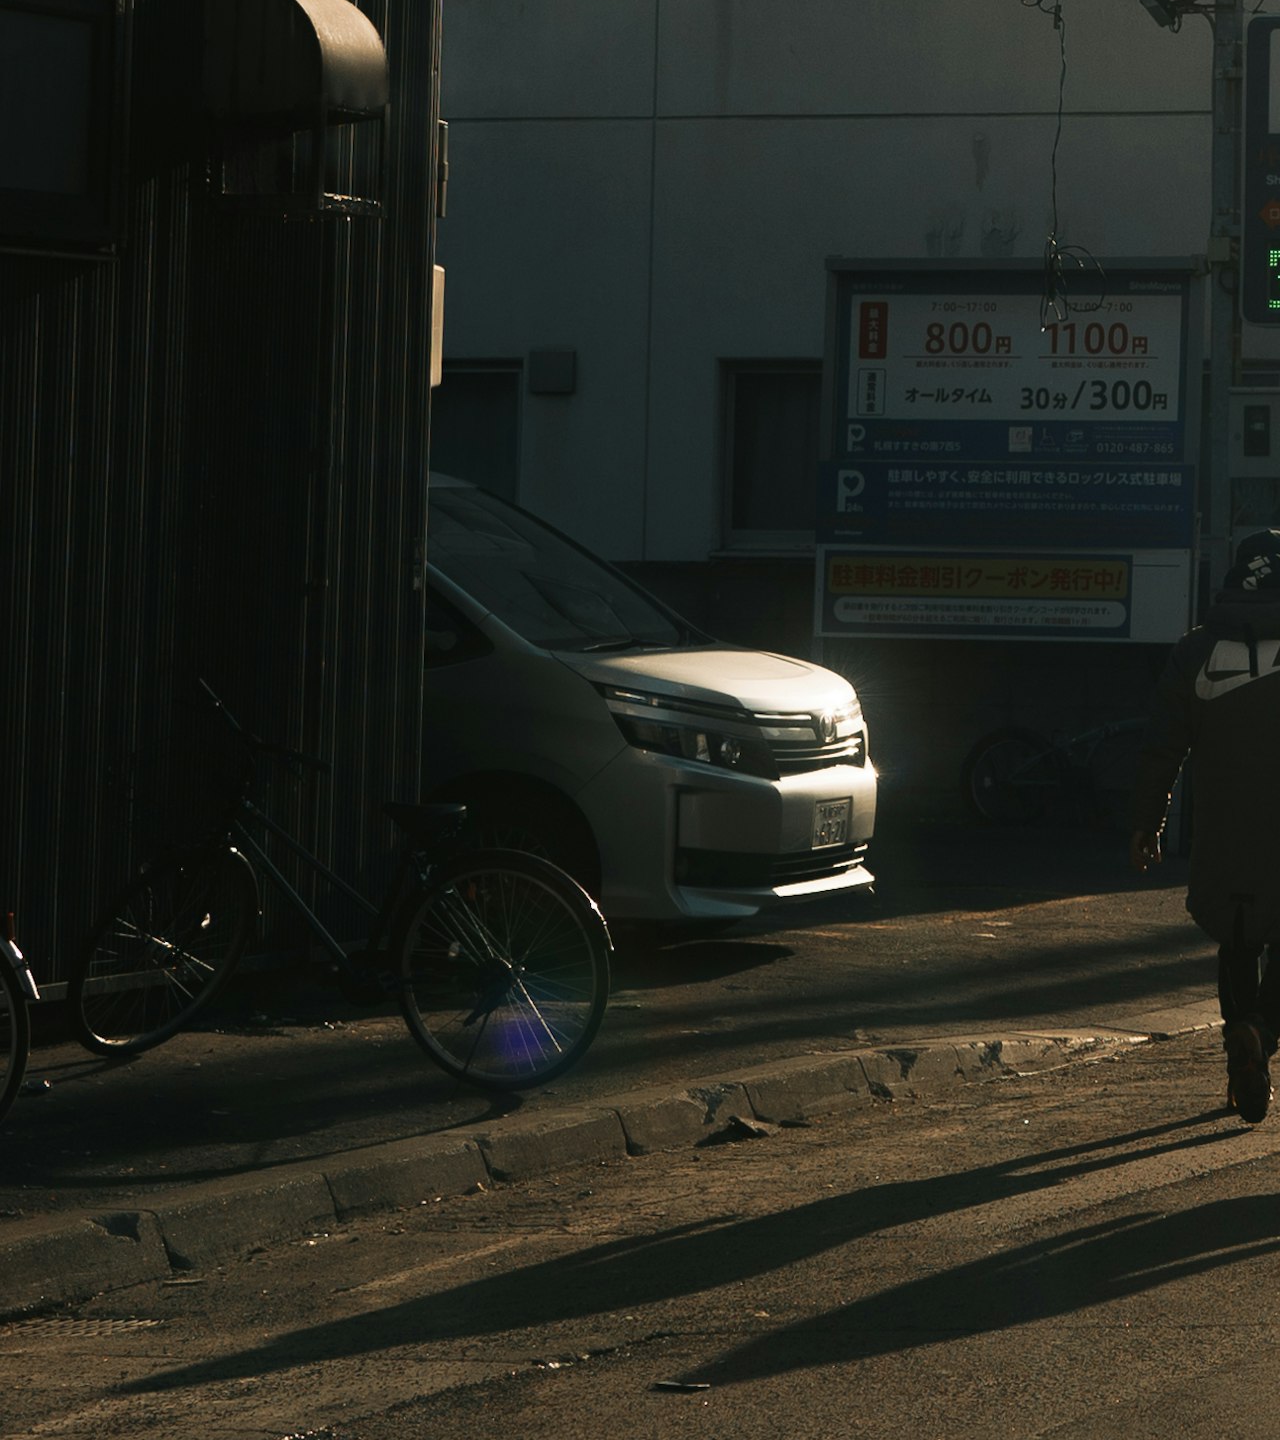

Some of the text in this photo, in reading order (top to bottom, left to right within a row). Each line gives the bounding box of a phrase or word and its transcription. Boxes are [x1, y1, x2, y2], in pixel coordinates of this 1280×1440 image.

[925, 322, 1012, 355] 800円
[904, 386, 993, 404] オールタイム
